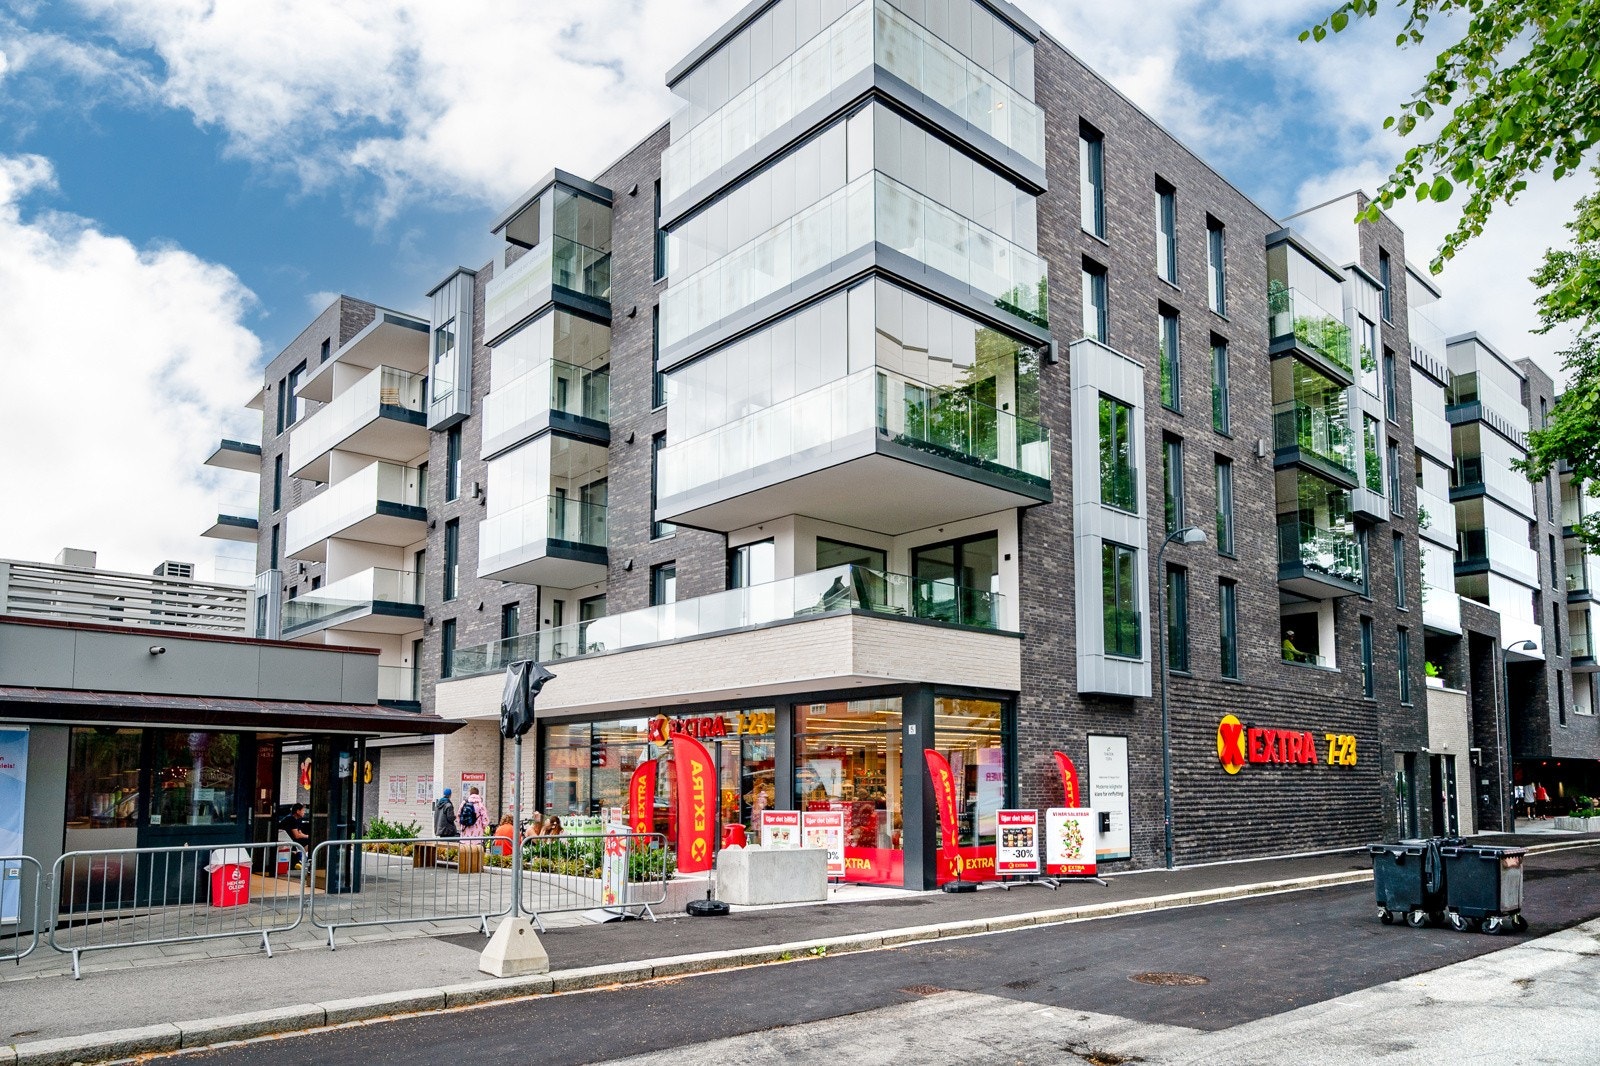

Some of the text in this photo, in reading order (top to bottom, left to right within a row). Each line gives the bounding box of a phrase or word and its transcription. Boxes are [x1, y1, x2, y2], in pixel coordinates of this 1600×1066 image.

[668, 716, 726, 738] EXTRA
[736, 712, 769, 735] 7-23
[1247, 727, 1319, 765] EXTRA
[1325, 733, 1357, 766] 7-23
[638, 775, 647, 818] EXTRA
[827, 851, 839, 860] 0%
[1012, 849, 1033, 858] -30%
[845, 857, 871, 869] XTRA
[966, 857, 994, 869] EXTRA
